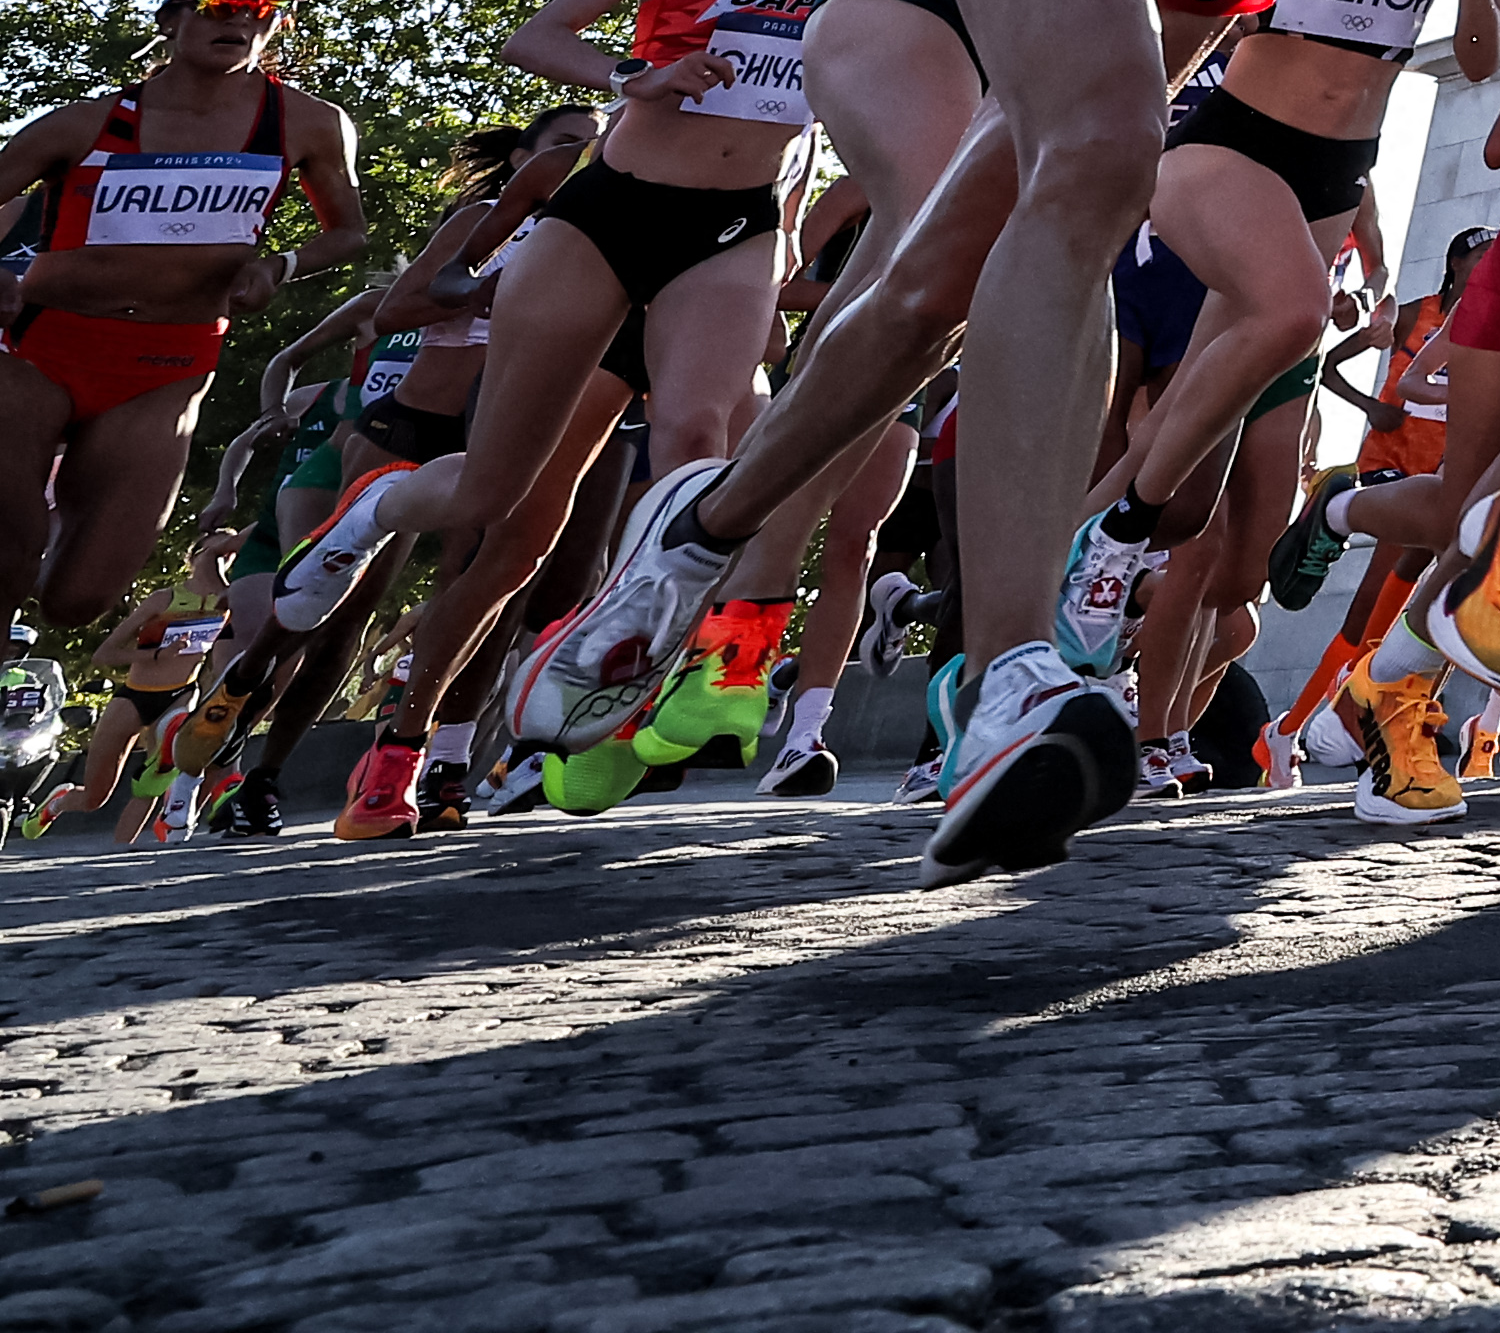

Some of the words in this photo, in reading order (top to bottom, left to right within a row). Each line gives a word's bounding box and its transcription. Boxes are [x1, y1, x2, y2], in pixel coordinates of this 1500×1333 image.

[762, 20, 800, 34] PARIS
[154, 156, 198, 166] PARIS
[203, 156, 242, 165] 2024
[95, 185, 270, 214] VALDIVIA
